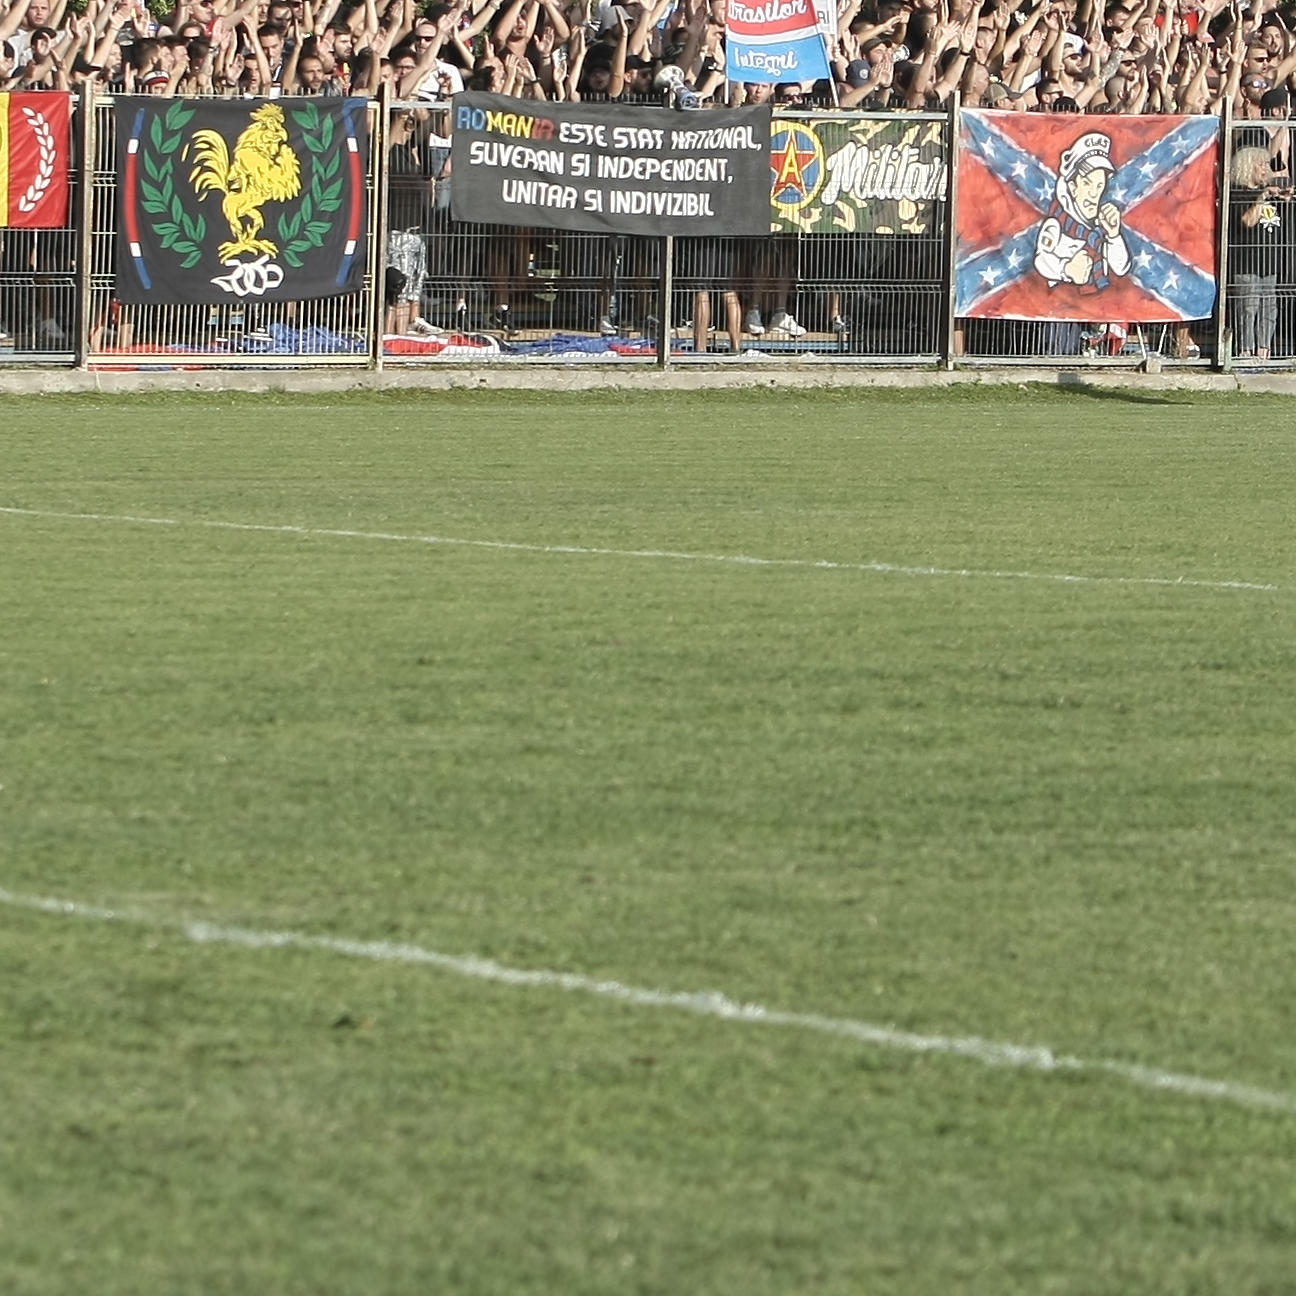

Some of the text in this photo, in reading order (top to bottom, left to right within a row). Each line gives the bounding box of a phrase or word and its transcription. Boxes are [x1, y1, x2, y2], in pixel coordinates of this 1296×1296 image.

[456, 106, 763, 151] ROMANIA ESTE STAT NATIONAL,
[469, 140, 735, 184] SUVERAN SI INDEPENDENT,
[501, 178, 715, 217] UNITAR SI INDIVIZIBIL
